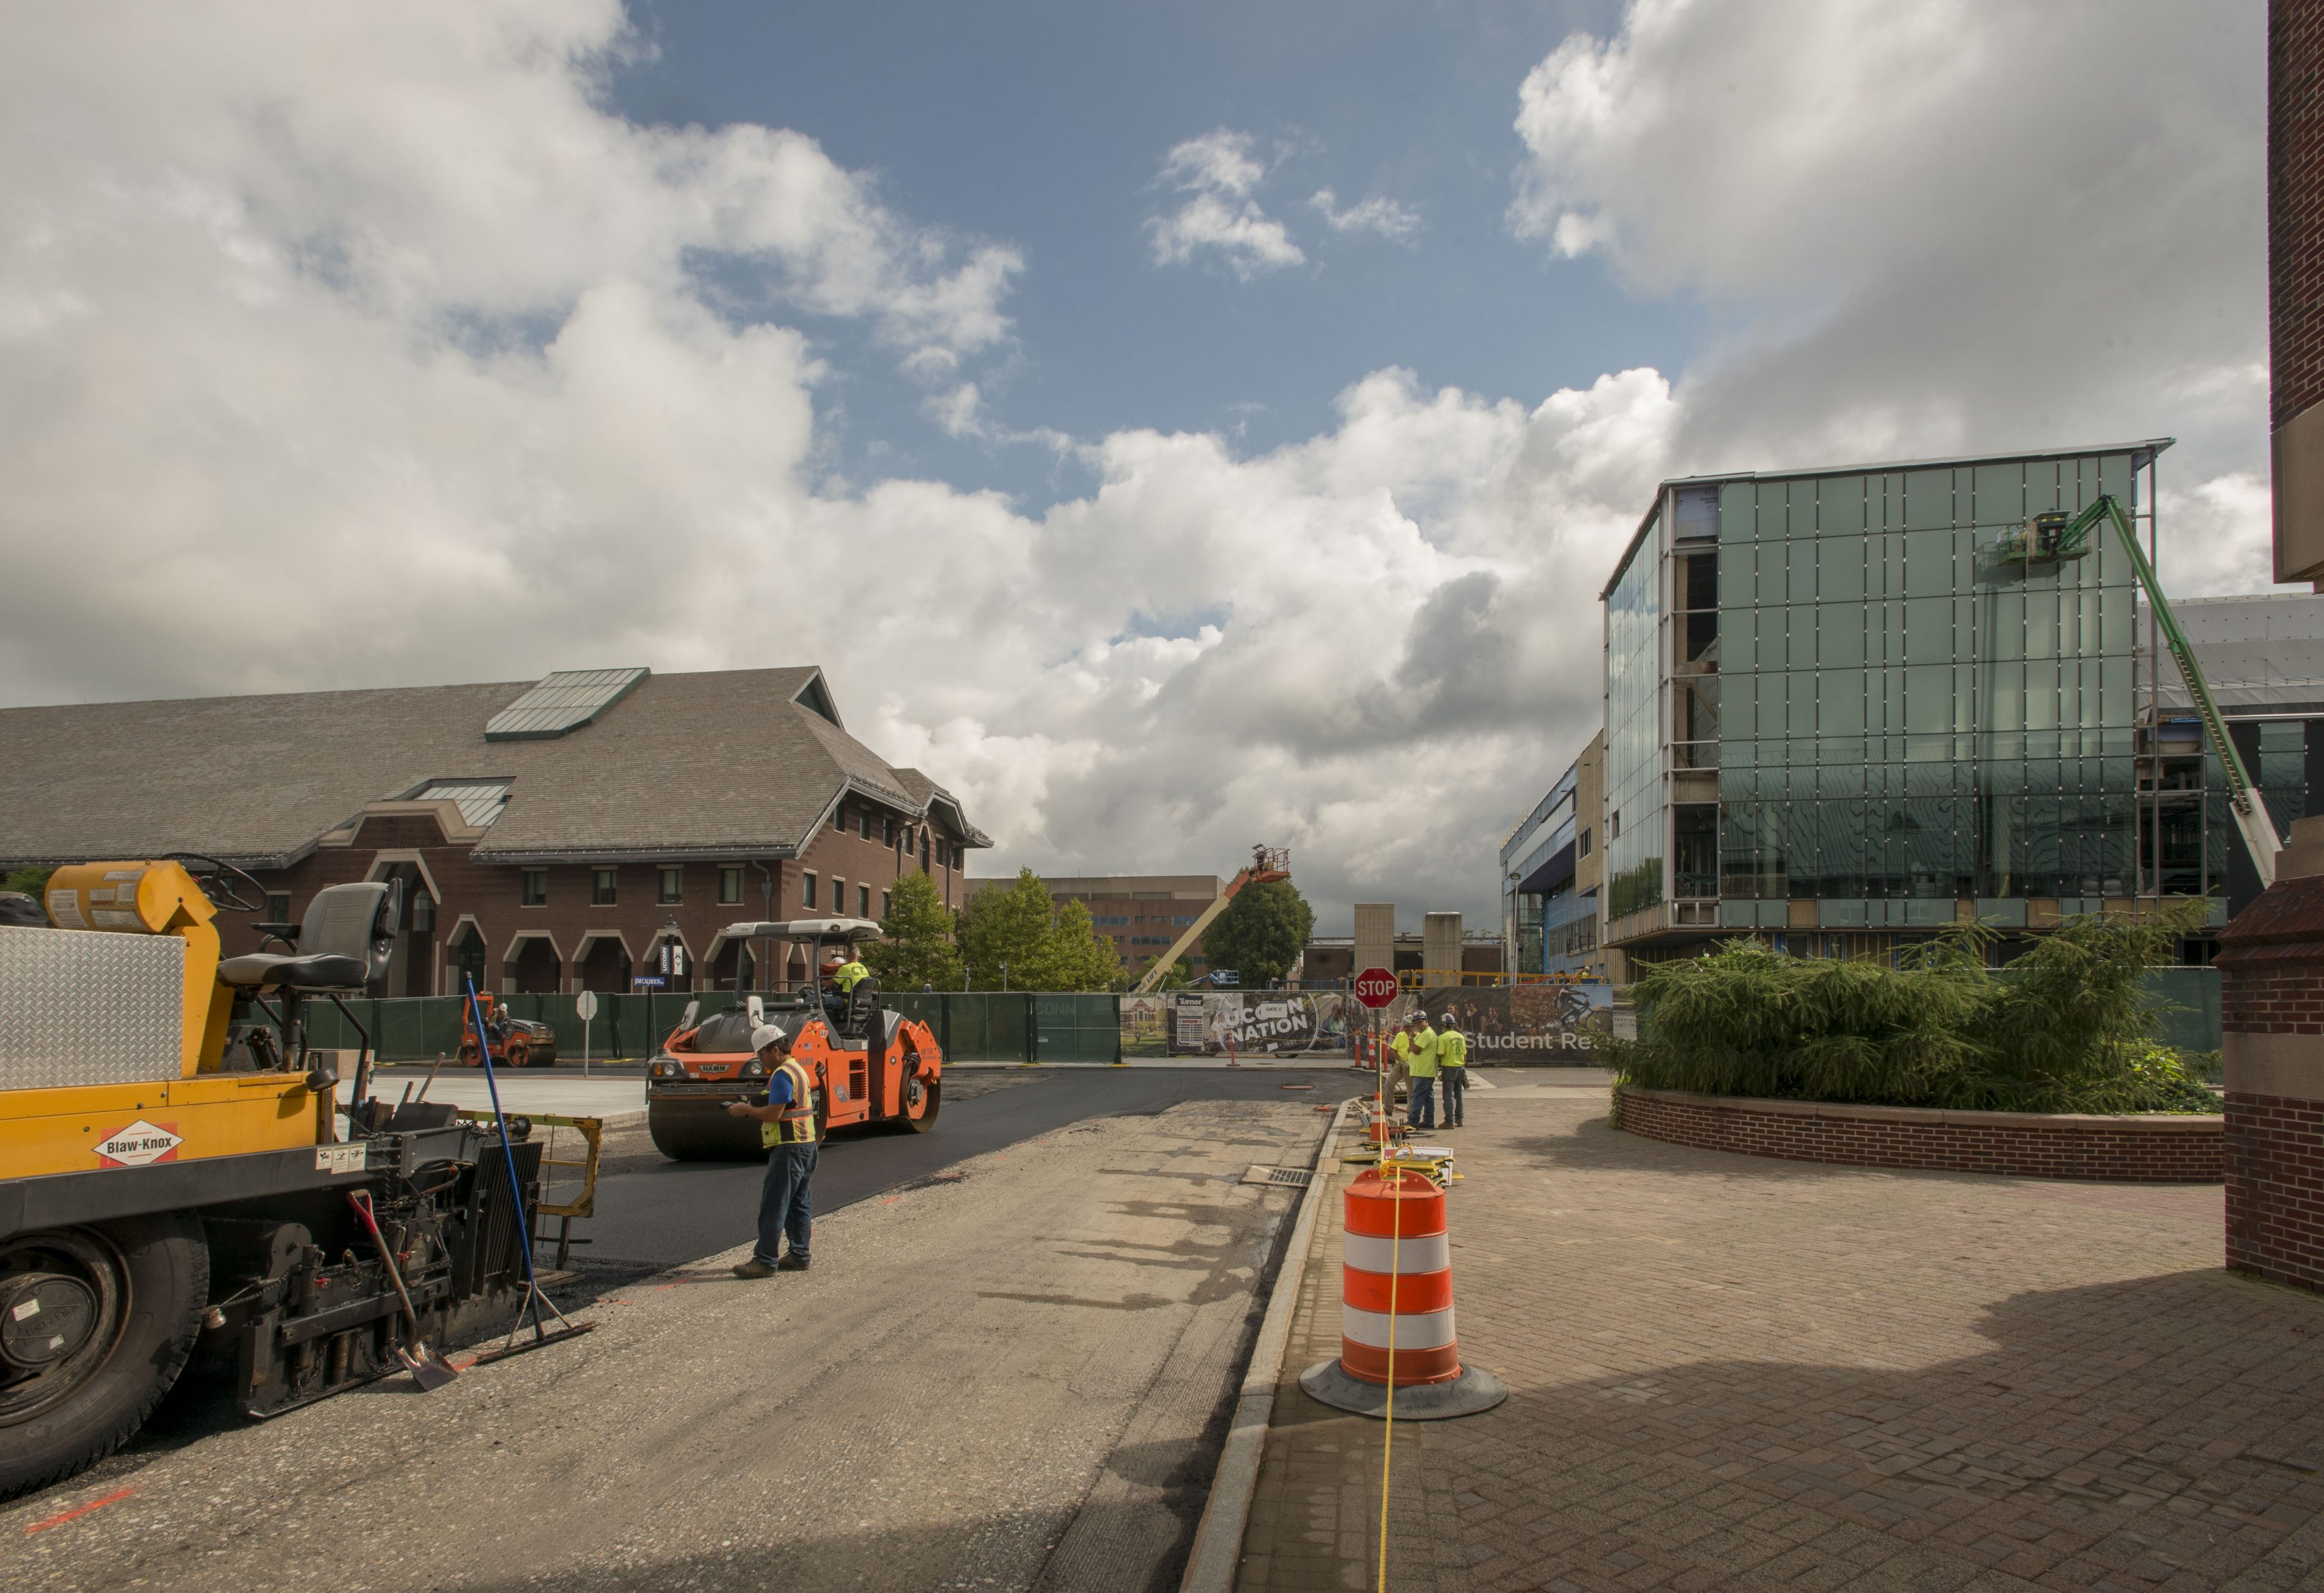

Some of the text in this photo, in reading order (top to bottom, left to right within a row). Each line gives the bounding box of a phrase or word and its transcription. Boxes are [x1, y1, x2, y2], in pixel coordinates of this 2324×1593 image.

[1147, 969, 1157, 982] LIFT
[1358, 980, 1395, 996] STOP
[1226, 997, 1304, 1026] UCN
[1228, 1014, 1308, 1043] NATION
[1464, 1031, 1553, 1049] Student
[107, 1137, 172, 1154] Blaw-Knox
